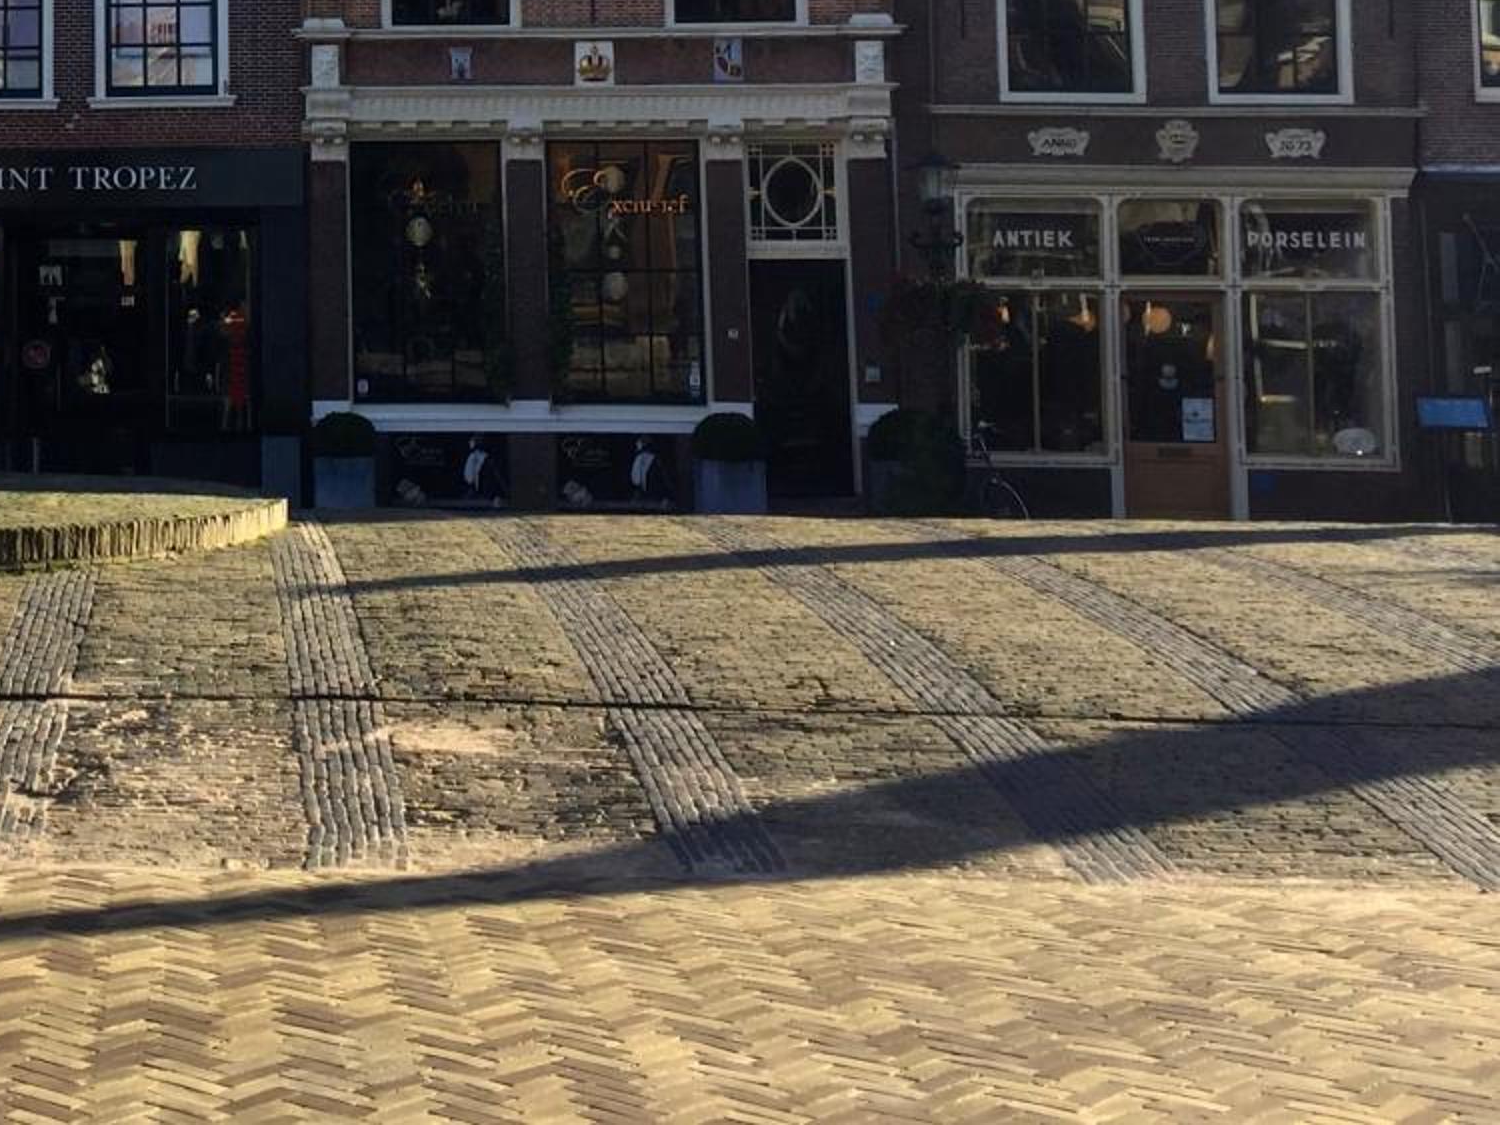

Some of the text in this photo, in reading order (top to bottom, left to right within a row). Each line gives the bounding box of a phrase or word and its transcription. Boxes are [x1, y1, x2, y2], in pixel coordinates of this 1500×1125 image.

[67, 165, 198, 191] TROPEZ
[993, 230, 1075, 248] ANTIEK
[1247, 230, 1366, 249] PORSELEIN
